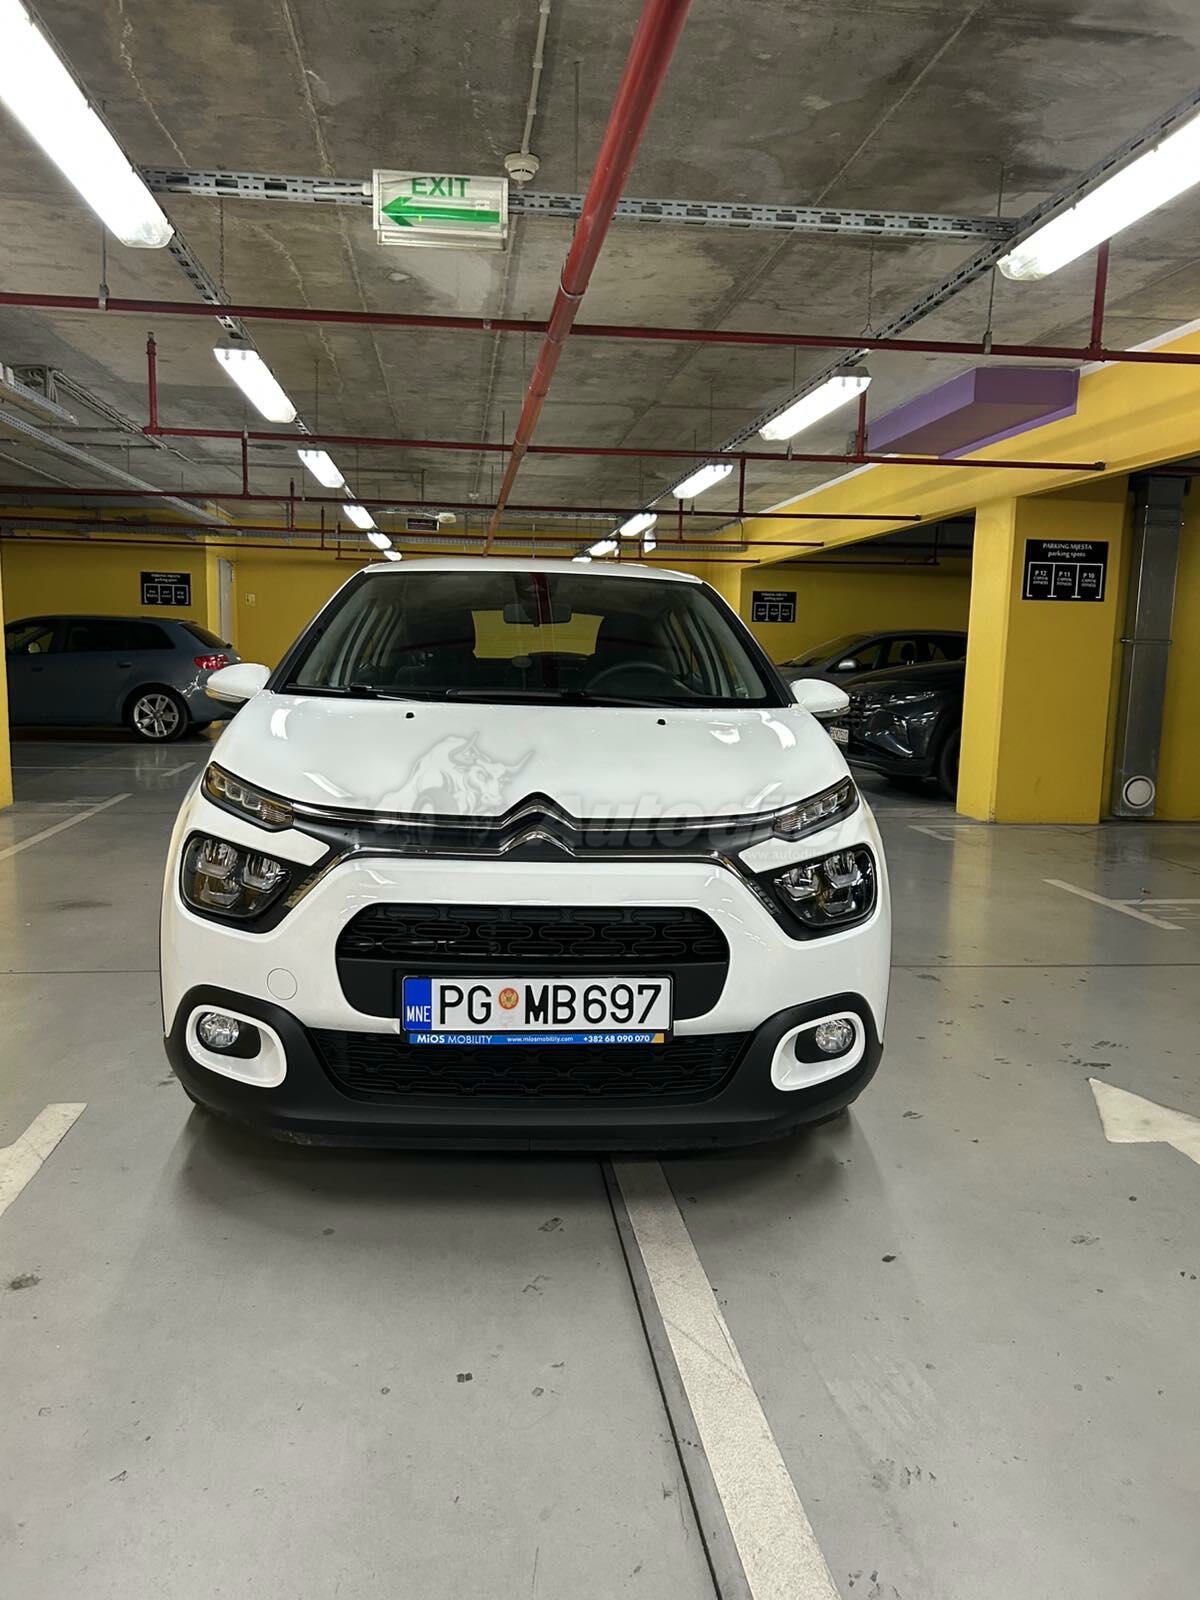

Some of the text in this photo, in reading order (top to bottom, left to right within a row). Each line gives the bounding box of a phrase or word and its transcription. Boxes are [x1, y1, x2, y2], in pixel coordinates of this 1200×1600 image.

[411, 176, 471, 198] EXIT
[1042, 542, 1070, 550] PARKING
[1047, 550, 1070, 559] parking
[439, 984, 662, 1025] PG MB697
[406, 1005, 431, 1023] MNE
[447, 1035, 493, 1044] MOBILITY
[583, 1035, 604, 1043] +382
[604, 1035, 616, 1043] 68
[617, 1034, 633, 1043] 090
[634, 1034, 650, 1043] 070
